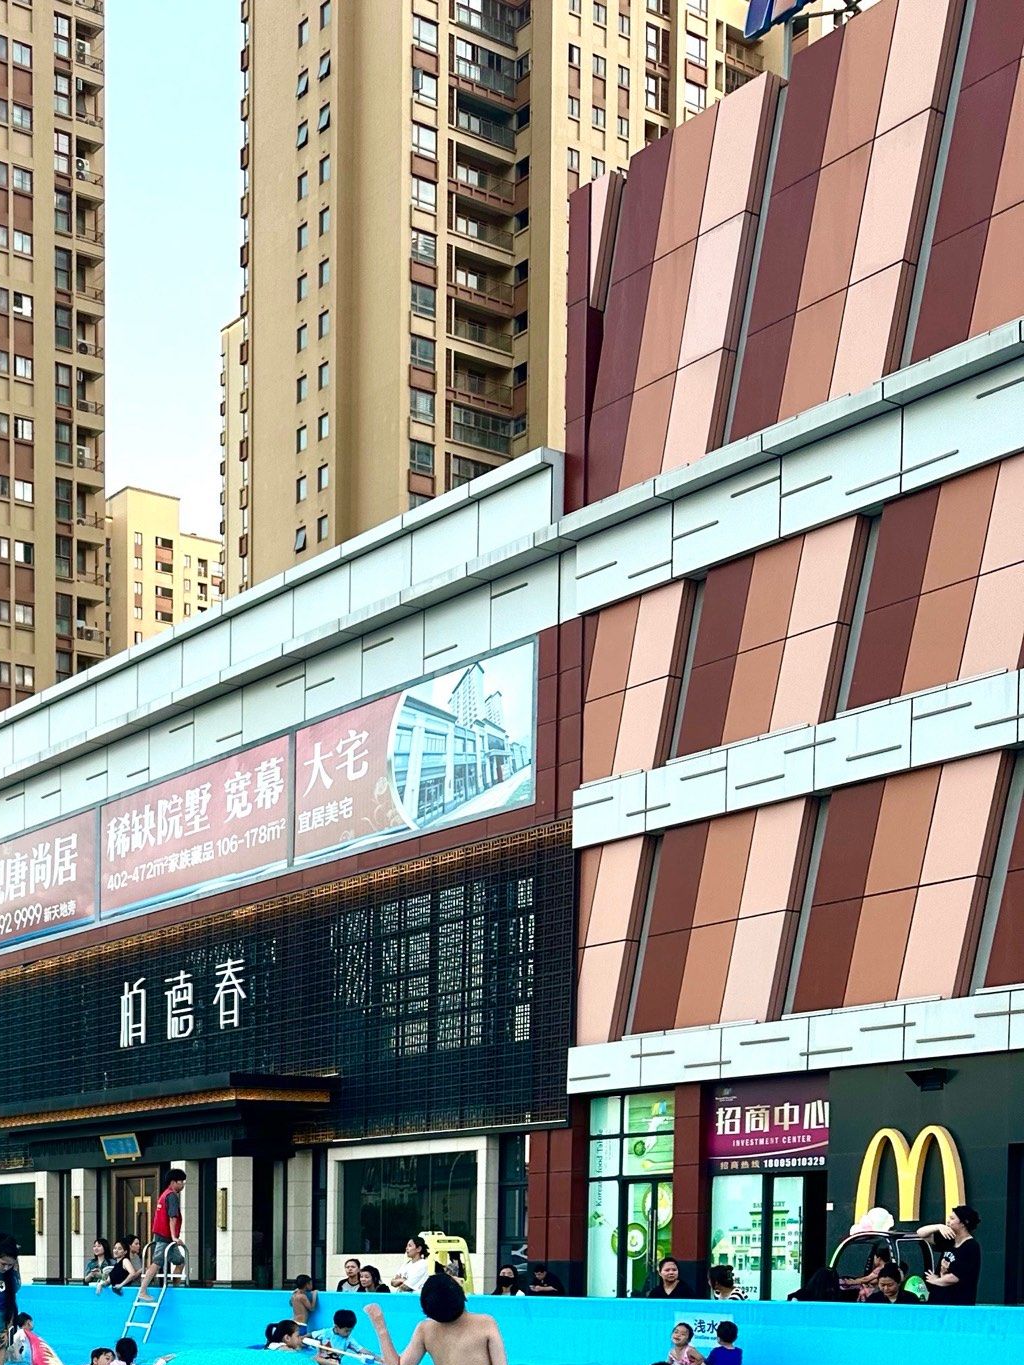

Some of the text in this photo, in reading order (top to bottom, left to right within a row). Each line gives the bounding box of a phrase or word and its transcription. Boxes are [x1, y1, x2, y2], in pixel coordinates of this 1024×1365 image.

[302, 730, 369, 798] 大宅
[106, 757, 285, 863] 稀缺院墅 宽幕
[297, 796, 353, 834] 宜居美宅
[14, 903, 43, 930] 9999
[715, 1099, 830, 1135] 招商中心
[732, 1134, 812, 1147] INVESTMENT CENTER
[720, 1160, 760, 1170] 招商热线
